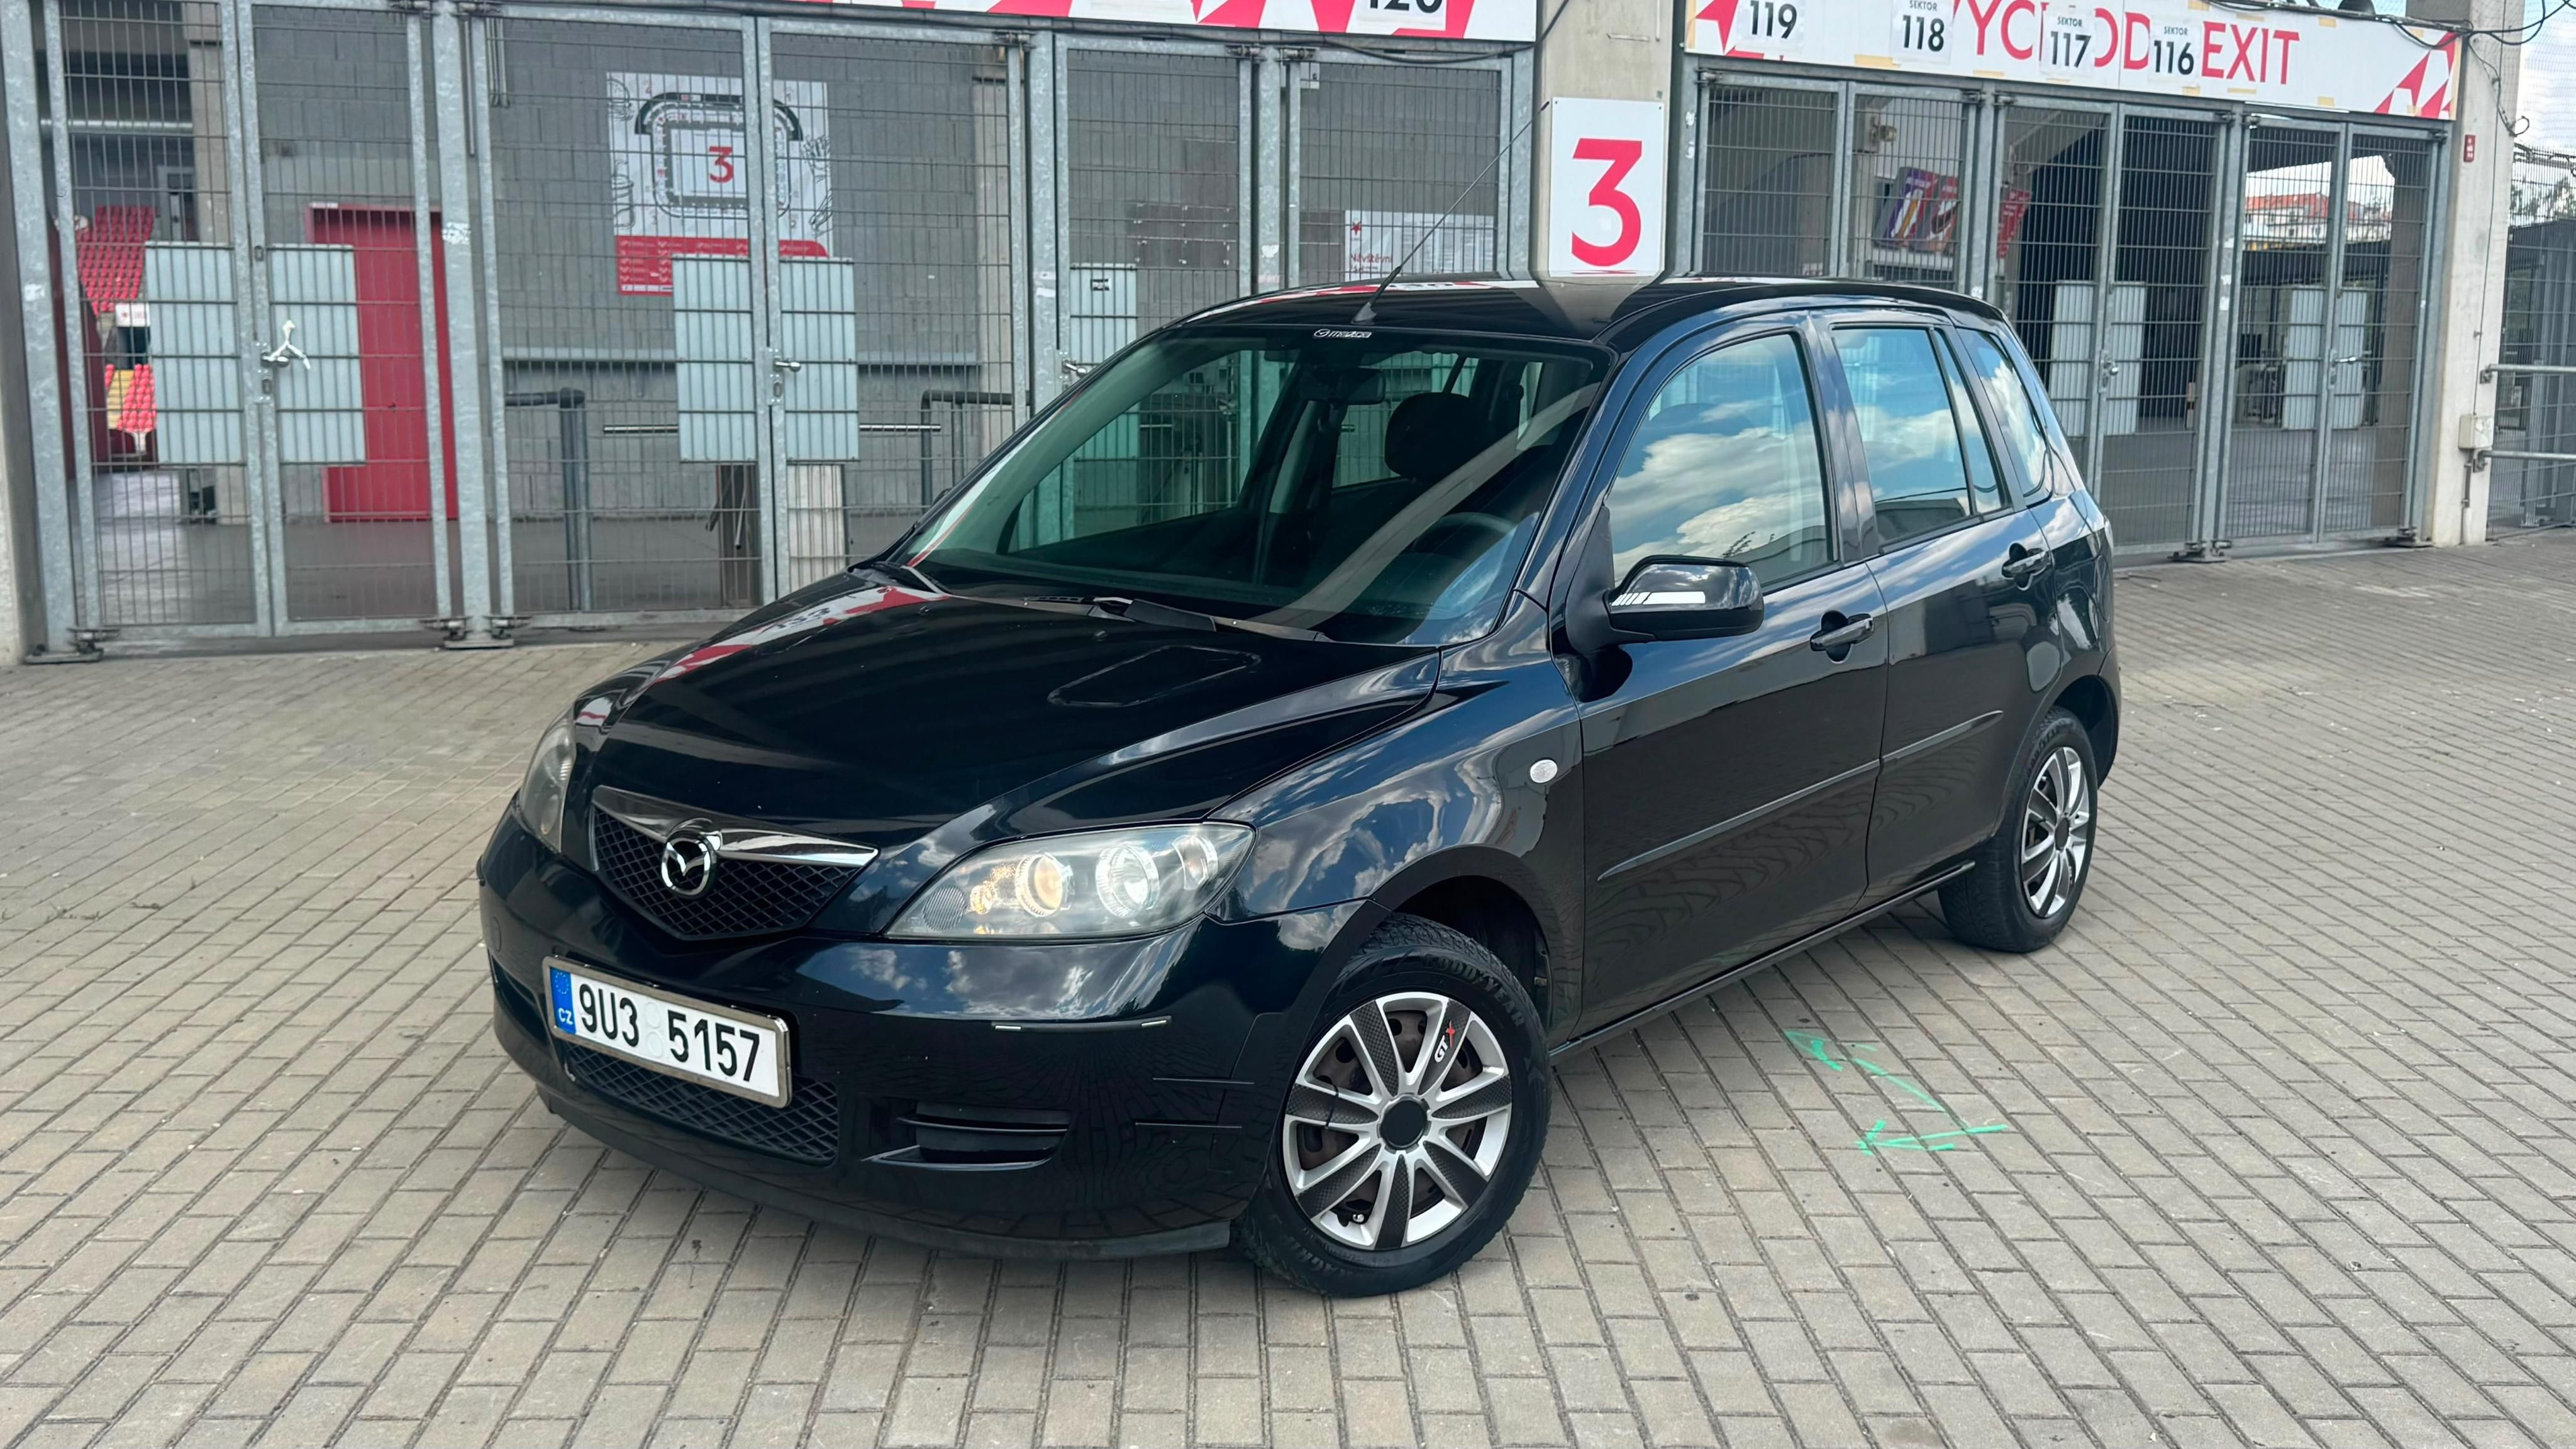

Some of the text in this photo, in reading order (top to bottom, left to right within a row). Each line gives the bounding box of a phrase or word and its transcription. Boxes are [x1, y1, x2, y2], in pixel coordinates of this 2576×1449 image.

[1749, 0, 1797, 40] 119
[1909, 0, 1938, 12] SEKTOR
[2057, 16, 2084, 28] SEKTOR
[1902, 14, 1945, 53] 118
[2163, 25, 2189, 36] SEKTOR
[2050, 31, 2091, 69] 117
[2153, 40, 2195, 75] 116
[2202, 21, 2301, 86] EXIT
[709, 146, 734, 183] 3
[1571, 137, 1643, 267] 3
[558, 983, 760, 1082] CZ 9U3 5157
